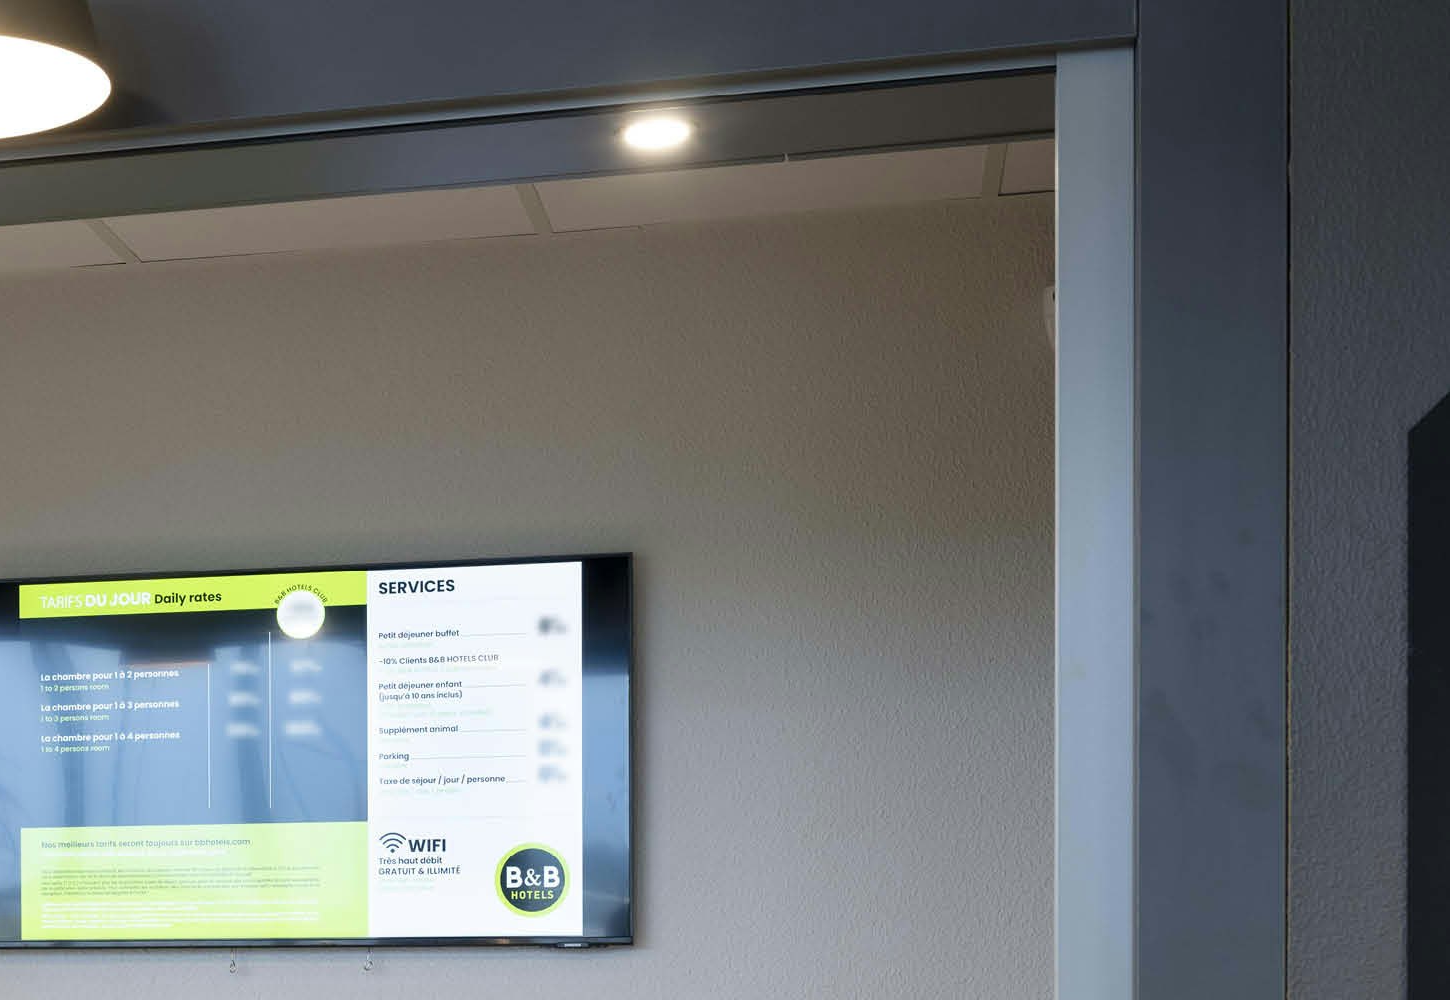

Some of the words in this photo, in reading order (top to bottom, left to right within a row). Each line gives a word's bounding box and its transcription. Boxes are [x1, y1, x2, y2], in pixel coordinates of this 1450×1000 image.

[378, 579, 455, 595] SERVICES
[286, 583, 313, 593] HOTELS
[312, 587, 329, 603] CLUB
[38, 594, 83, 609] TARIFS
[85, 593, 107, 608] DU
[110, 591, 151, 606] JOUR
[154, 592, 187, 606] Daily
[189, 591, 222, 603] rates
[378, 632, 396, 640] Petit
[398, 630, 434, 641] déjeuner
[435, 629, 460, 638] buffet
[378, 657, 398, 665] -10%
[399, 656, 427, 664] Clients
[428, 655, 446, 664] B&B
[446, 654, 477, 663] HOTELS
[477, 654, 499, 662] CLUB
[41, 673, 50, 682] La
[52, 672, 91, 681] chambre
[92, 672, 113, 682] pour
[134, 669, 180, 680] personnes
[45, 684, 52, 692] to
[60, 684, 88, 693] persons
[378, 682, 397, 690] Petit
[398, 681, 434, 692] déjeuner
[435, 680, 463, 689] enfant
[411, 692, 420, 700] 10
[436, 690, 463, 700] inclus)
[41, 704, 50, 712] La
[52, 703, 91, 712] chambre
[92, 703, 113, 712] pour
[134, 701, 180, 711] personnes
[60, 713, 89, 723] persons
[89, 713, 110, 721] room
[378, 726, 428, 736] Supplément
[429, 725, 459, 733] animal
[41, 735, 50, 743] La
[52, 734, 91, 743] chambre
[92, 734, 113, 743] pour
[134, 731, 180, 742] personnes
[89, 744, 110, 752] room
[378, 752, 410, 762] Parking
[379, 777, 398, 785] Taxe
[399, 776, 411, 785] de
[411, 776, 436, 786] séjour
[443, 775, 460, 786] jour
[466, 775, 506, 785] personne
[408, 838, 447, 853] WIFI
[378, 857, 397, 866] Très
[398, 856, 419, 865] haut
[420, 856, 443, 865] débit
[378, 867, 417, 876] GRATUIT
[418, 867, 425, 875] &
[426, 866, 461, 875] ILLIMITÉ
[506, 865, 560, 889] B&B
[510, 890, 555, 900] HOTELS
